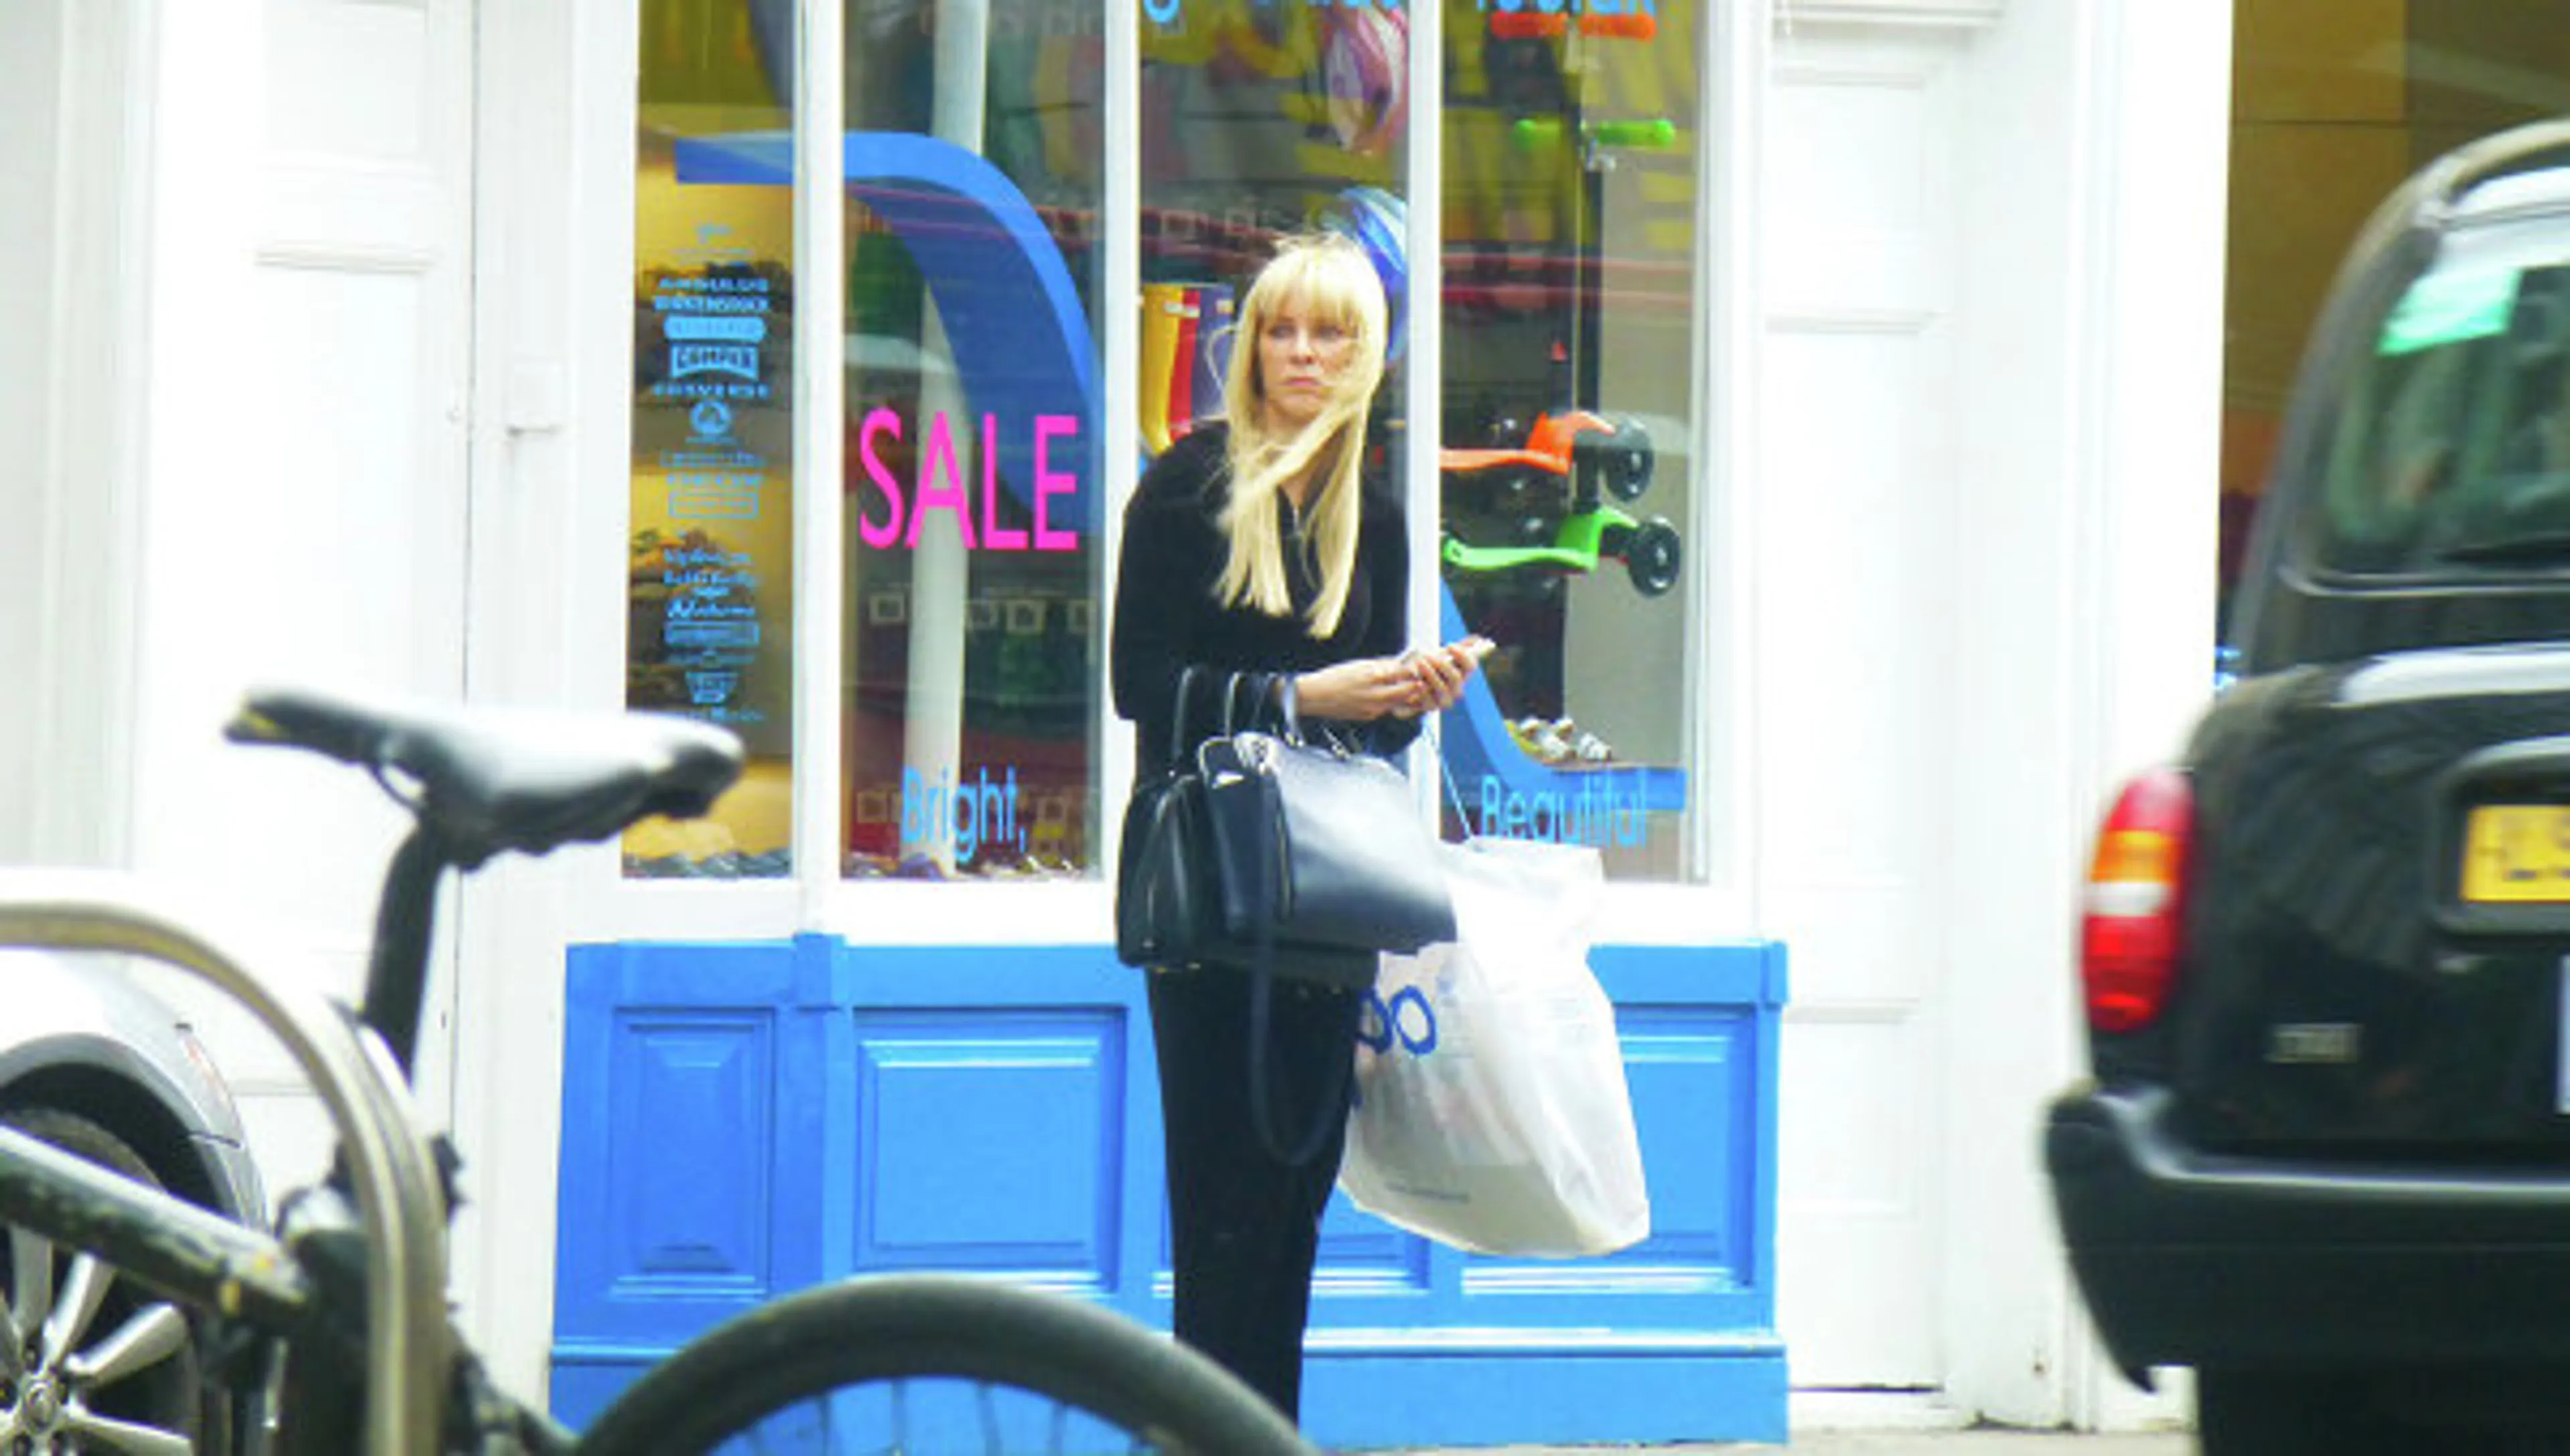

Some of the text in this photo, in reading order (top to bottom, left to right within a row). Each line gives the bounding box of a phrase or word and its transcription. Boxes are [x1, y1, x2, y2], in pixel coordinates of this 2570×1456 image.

[860, 407, 1078, 550] SALE
[900, 765, 1027, 863] Bright,
[1481, 766, 1647, 849] Beautiful
